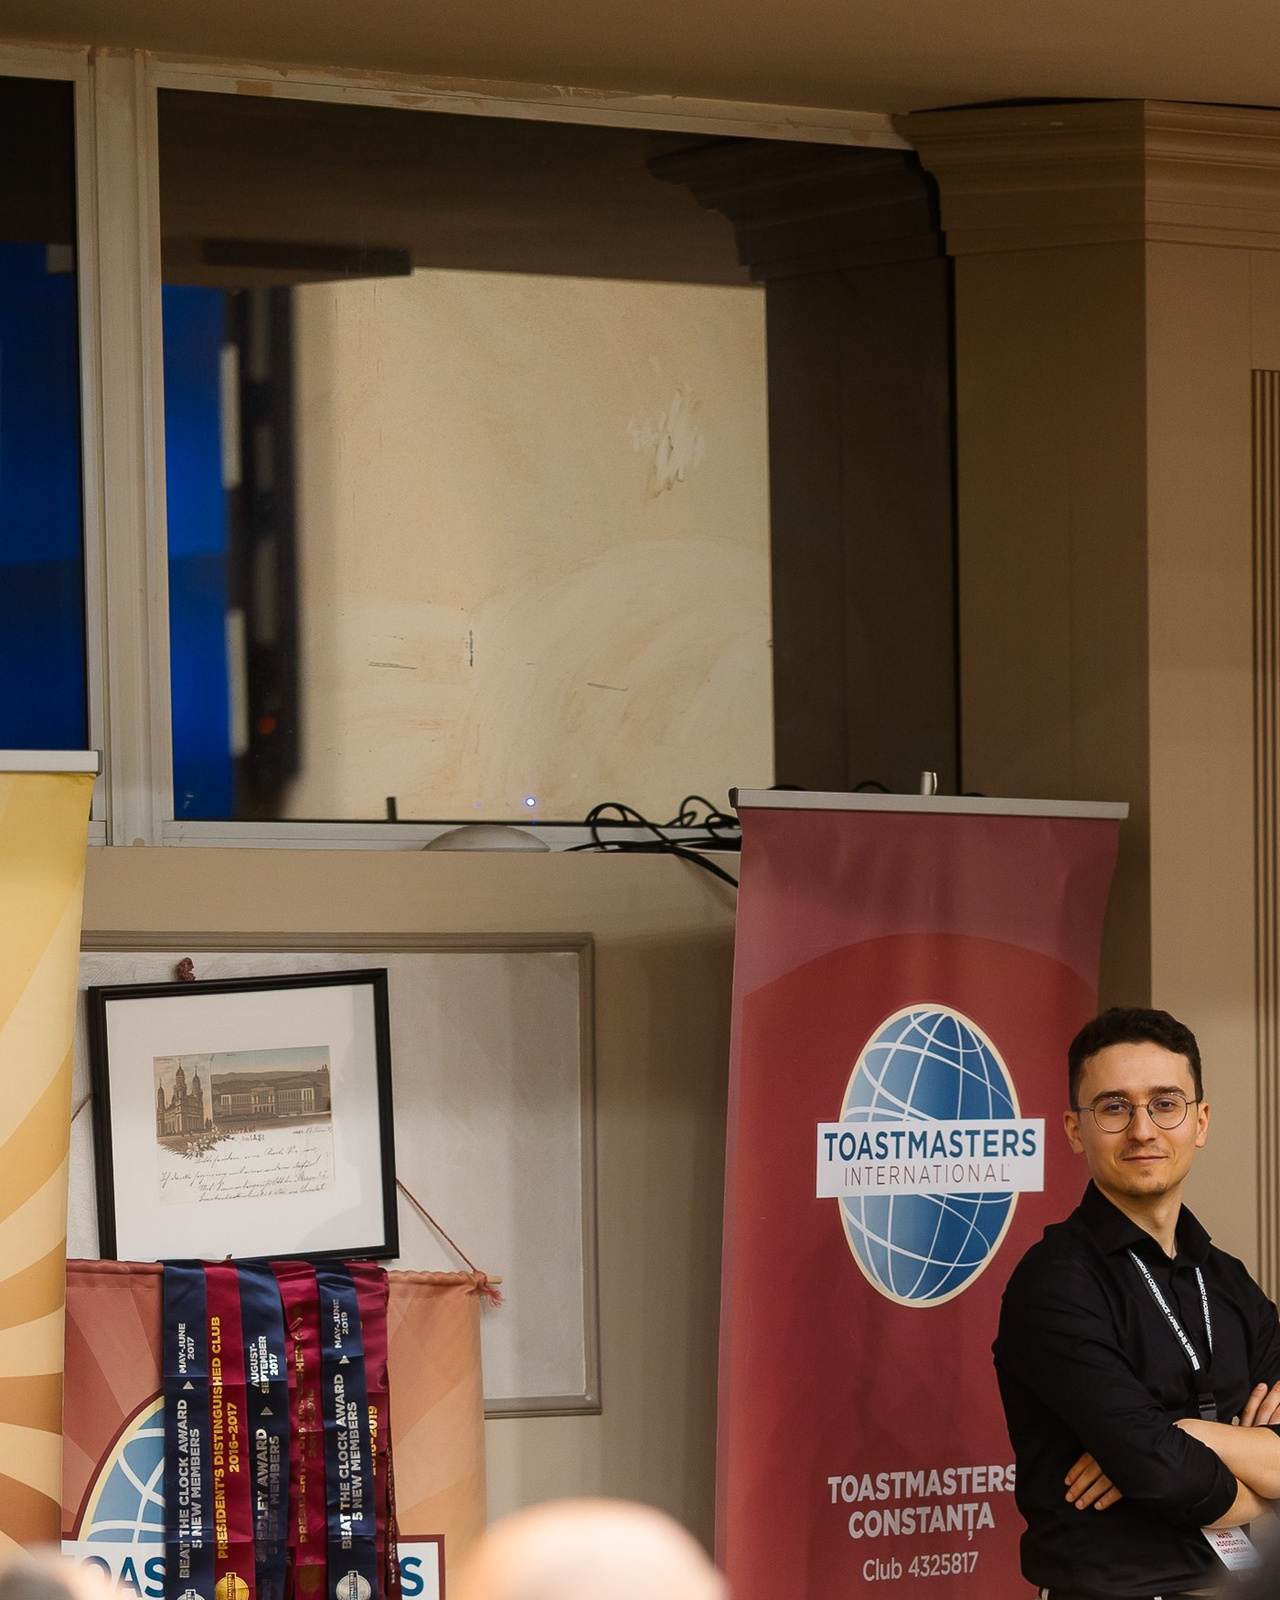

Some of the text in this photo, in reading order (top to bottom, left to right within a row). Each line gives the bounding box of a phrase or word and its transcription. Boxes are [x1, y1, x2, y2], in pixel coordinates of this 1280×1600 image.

[824, 1128, 1037, 1161] TOASTMASTERS
[844, 1163, 1010, 1187] INTERNATIONAL
[250, 1342, 260, 1388] AUGUST-
[258, 1335, 270, 1394] SEPTEMBER
[269, 1353, 279, 1376] 2017
[187, 1336, 203, 1549] 5 NEW MEMBERS 2017
[211, 1316, 229, 1559] PRESIDENT'S DISTINGUISHED CLUB
[227, 1402, 240, 1473] 2016-2017
[332, 1299, 352, 1549] BEAT THE CLOCK AWARD MAY-JUNE
[341, 1312, 363, 1521] 5 NEW MEMBERS 2019
[177, 1323, 190, 1578] BEAT THE CLOCK AWARD MAY-JUNE
[255, 1428, 268, 1487] AWARD
[269, 1435, 280, 1505] MEMBERS
[827, 1463, 1016, 1504] TOASTMASTERS
[848, 1502, 995, 1541] CONSTANȚA
[862, 1551, 979, 1582] Club 4325817
